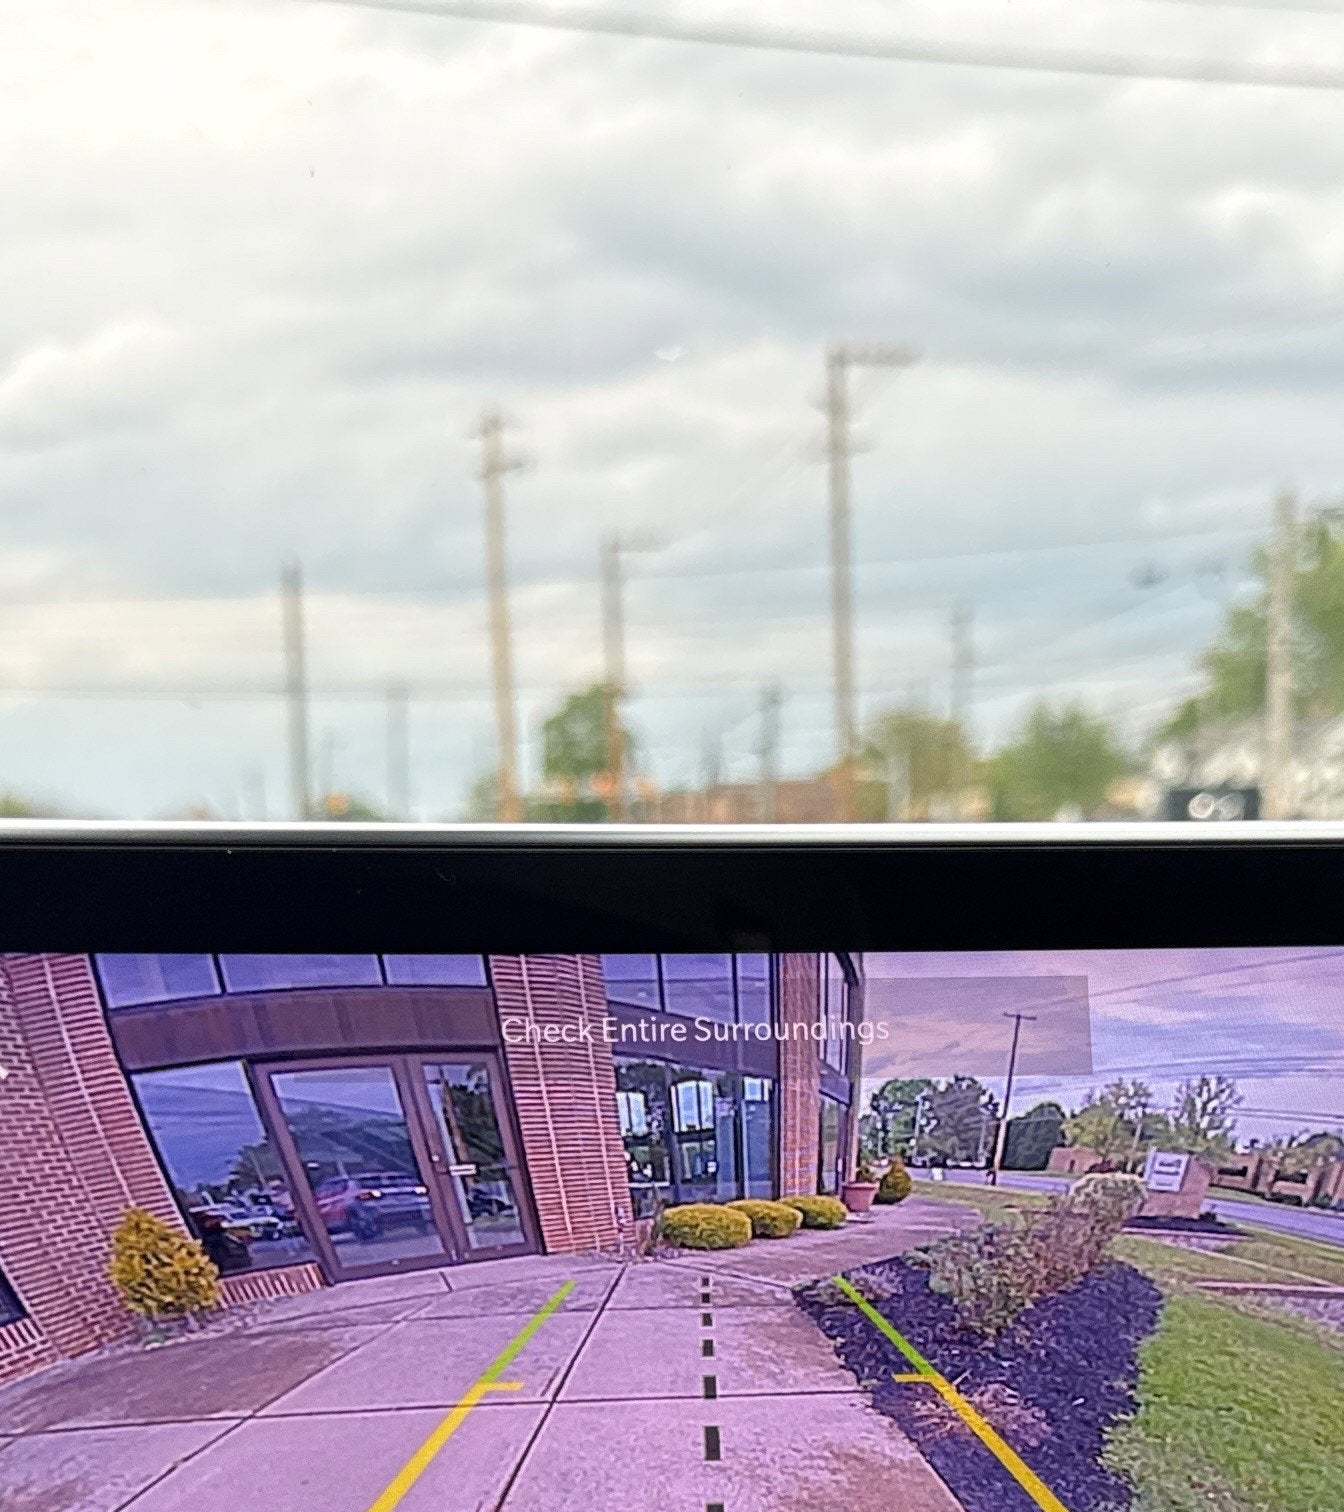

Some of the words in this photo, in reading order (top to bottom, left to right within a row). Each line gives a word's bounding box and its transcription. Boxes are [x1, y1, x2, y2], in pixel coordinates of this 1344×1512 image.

[500, 1017, 595, 1043] Check
[601, 1017, 687, 1043] Entire
[694, 1016, 890, 1046] Surroundings
